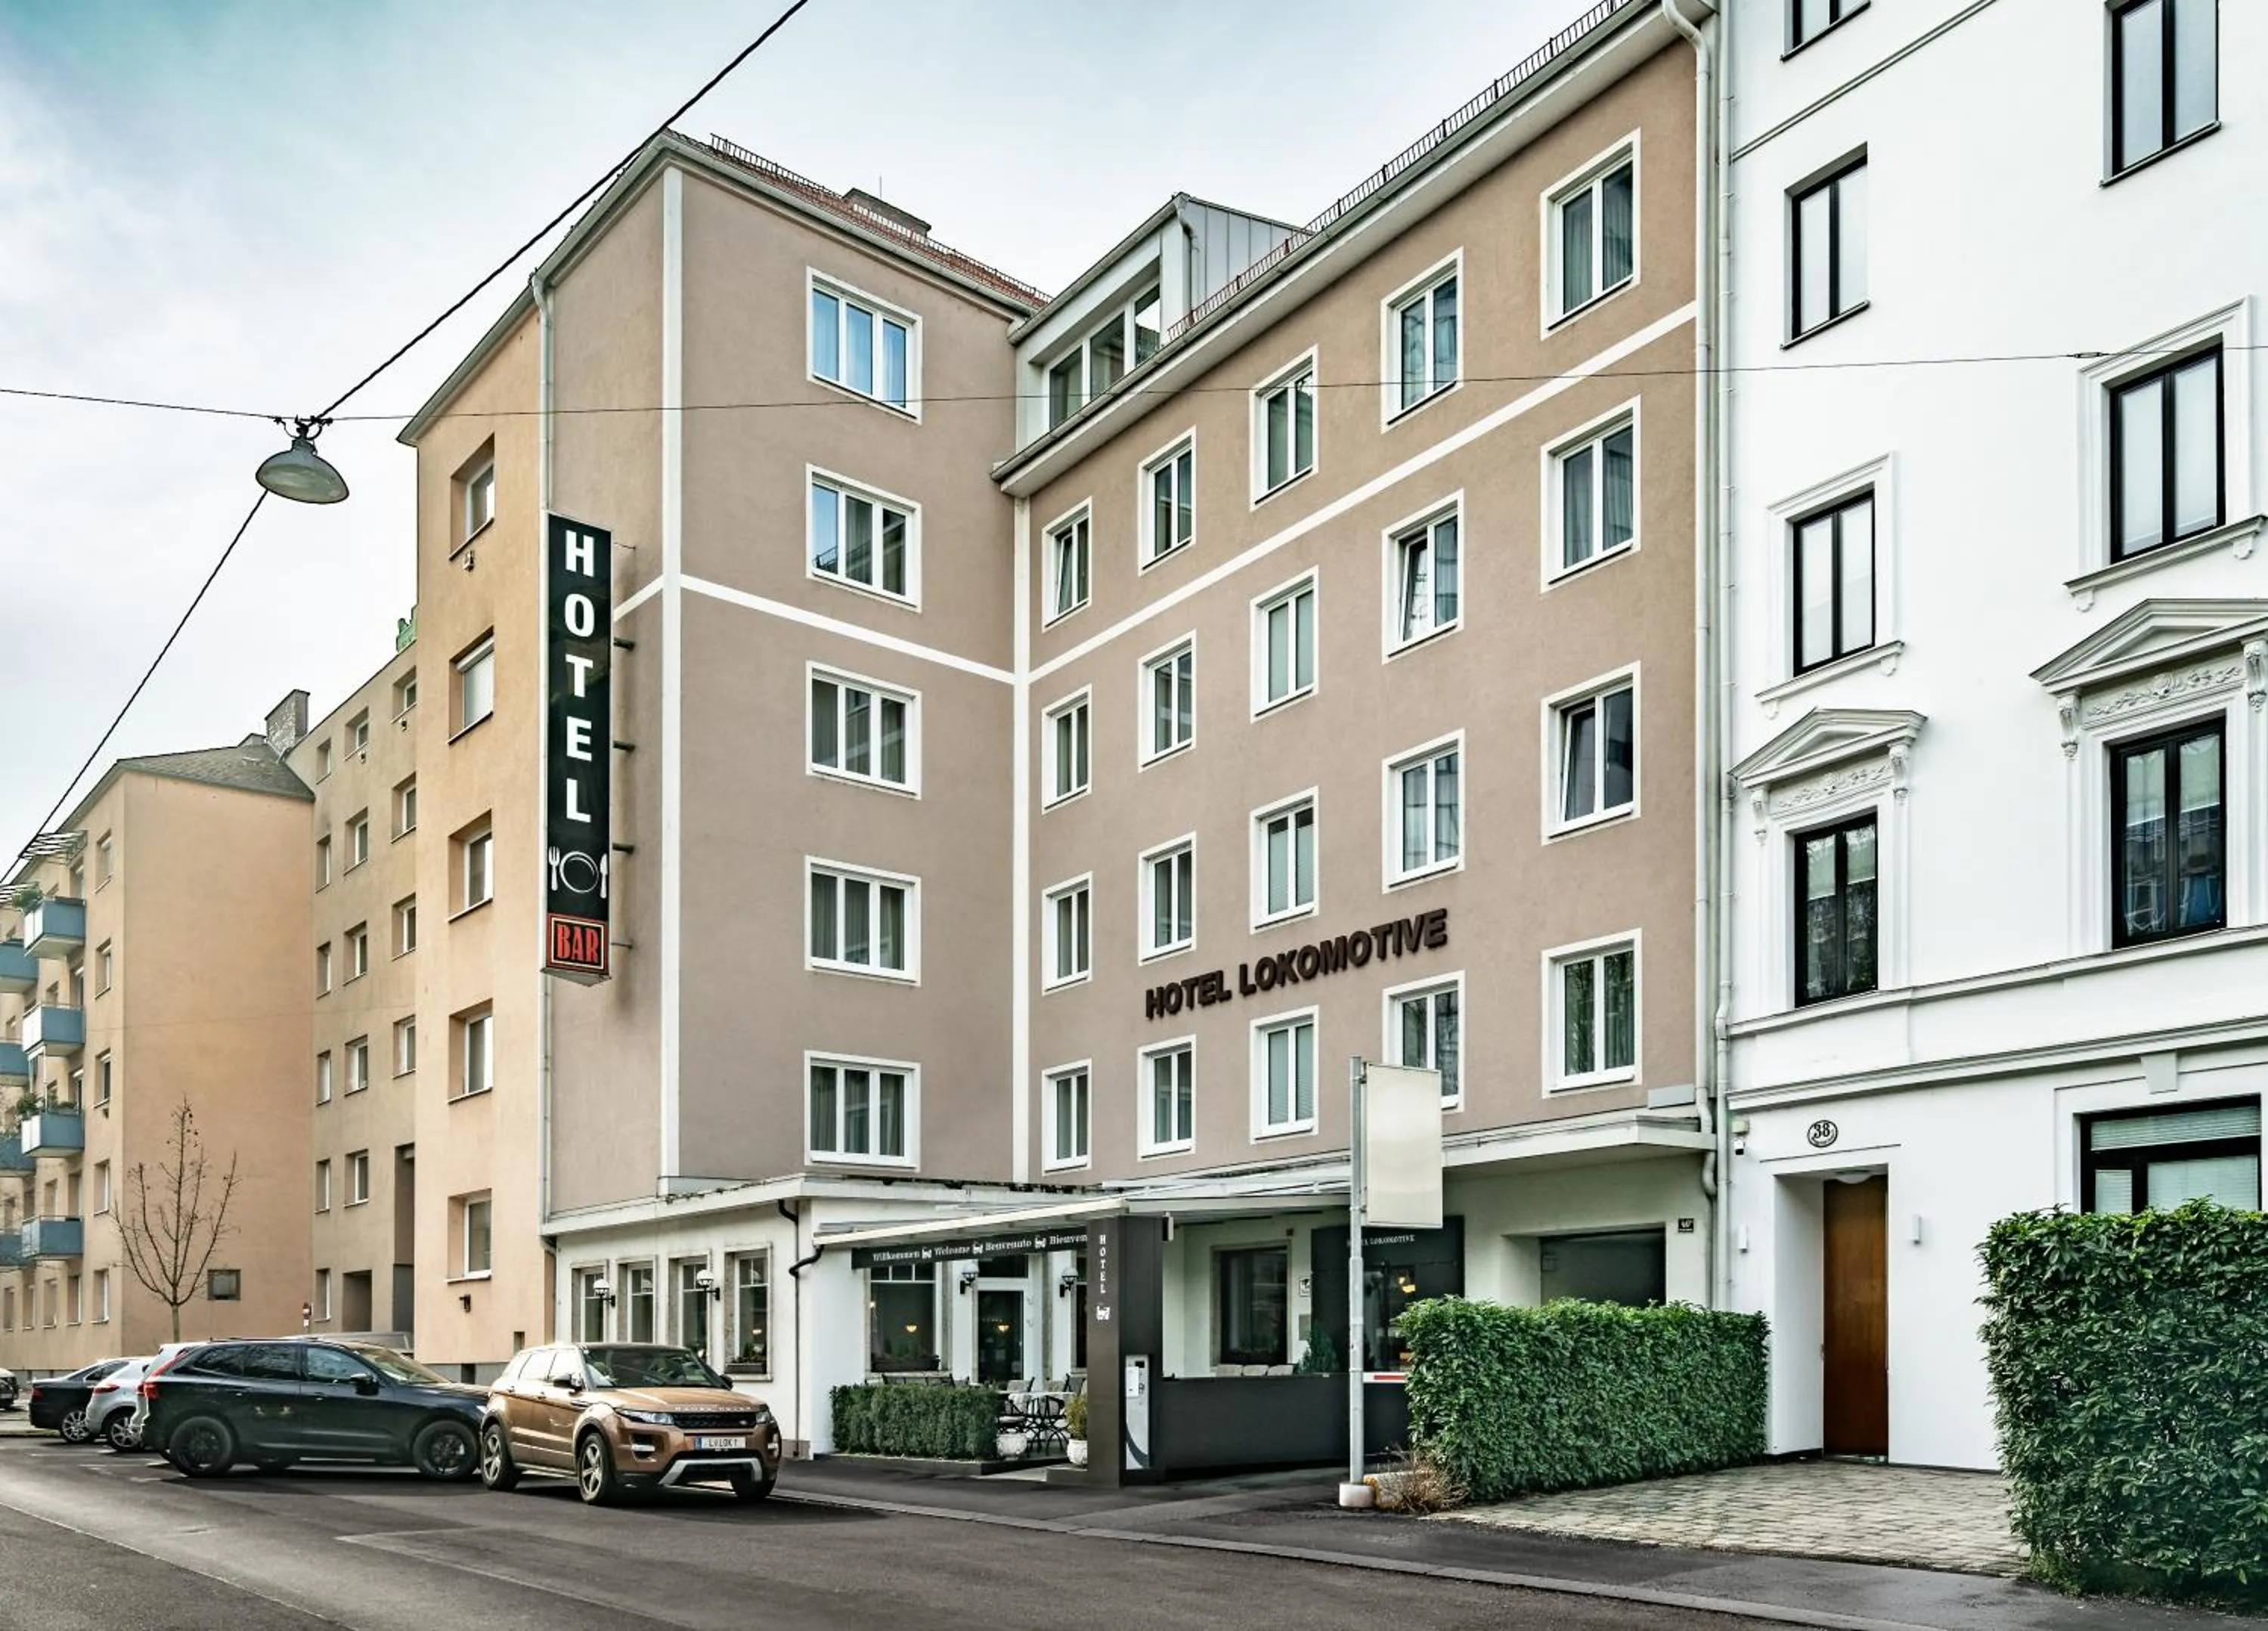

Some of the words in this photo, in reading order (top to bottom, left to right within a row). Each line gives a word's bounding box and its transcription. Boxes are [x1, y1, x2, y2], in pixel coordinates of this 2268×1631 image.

[564, 529, 595, 823] HOTEL
[556, 924, 599, 963] BAR
[1145, 970, 1232, 1020] HOTEL
[1239, 908, 1448, 996] LOKOMOTIVE
[1814, 1122, 1830, 1138] 38
[1049, 1234, 1088, 1245] Bienven
